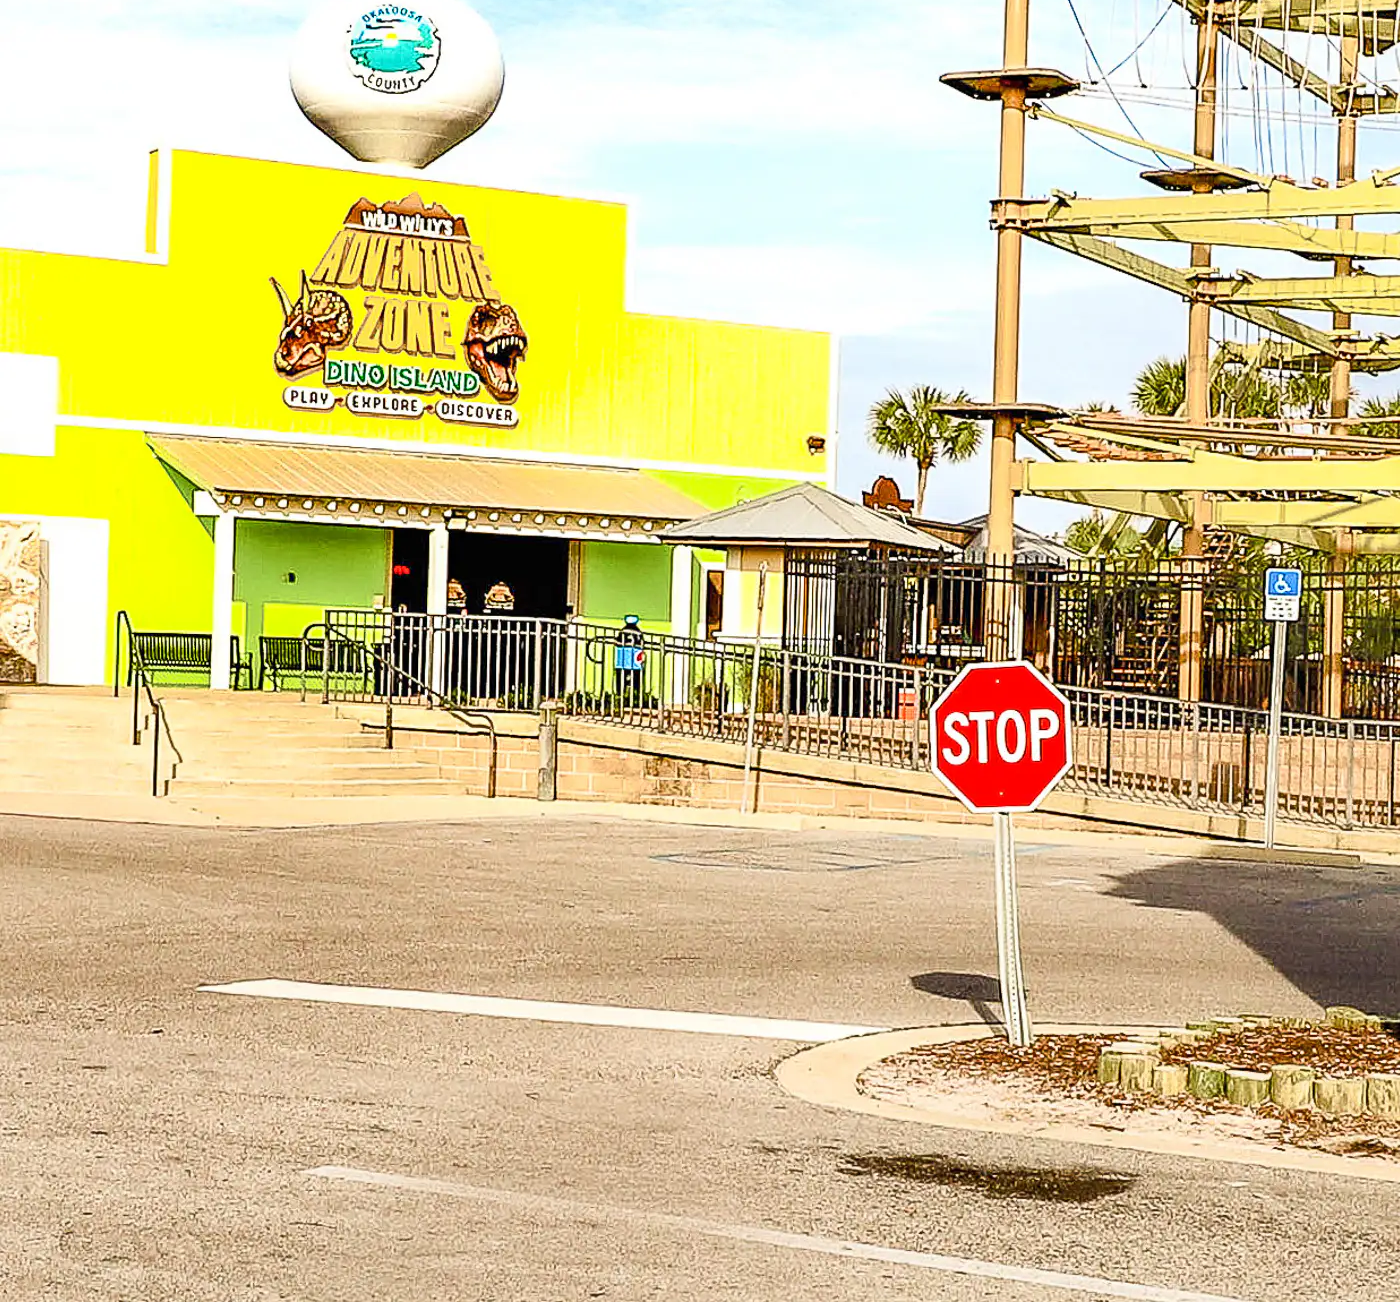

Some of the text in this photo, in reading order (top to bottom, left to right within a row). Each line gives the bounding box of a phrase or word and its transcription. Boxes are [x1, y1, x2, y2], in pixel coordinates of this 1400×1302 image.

[361, 6, 423, 23] OKALOOSA
[367, 73, 416, 90] COUNTY
[309, 229, 502, 303] ADVENTURE
[353, 296, 456, 359] ZONE
[326, 360, 480, 393] DINO ISLAND
[290, 390, 513, 422] PLAY EXPLORE DISCOVER
[942, 709, 1060, 766] STOP
